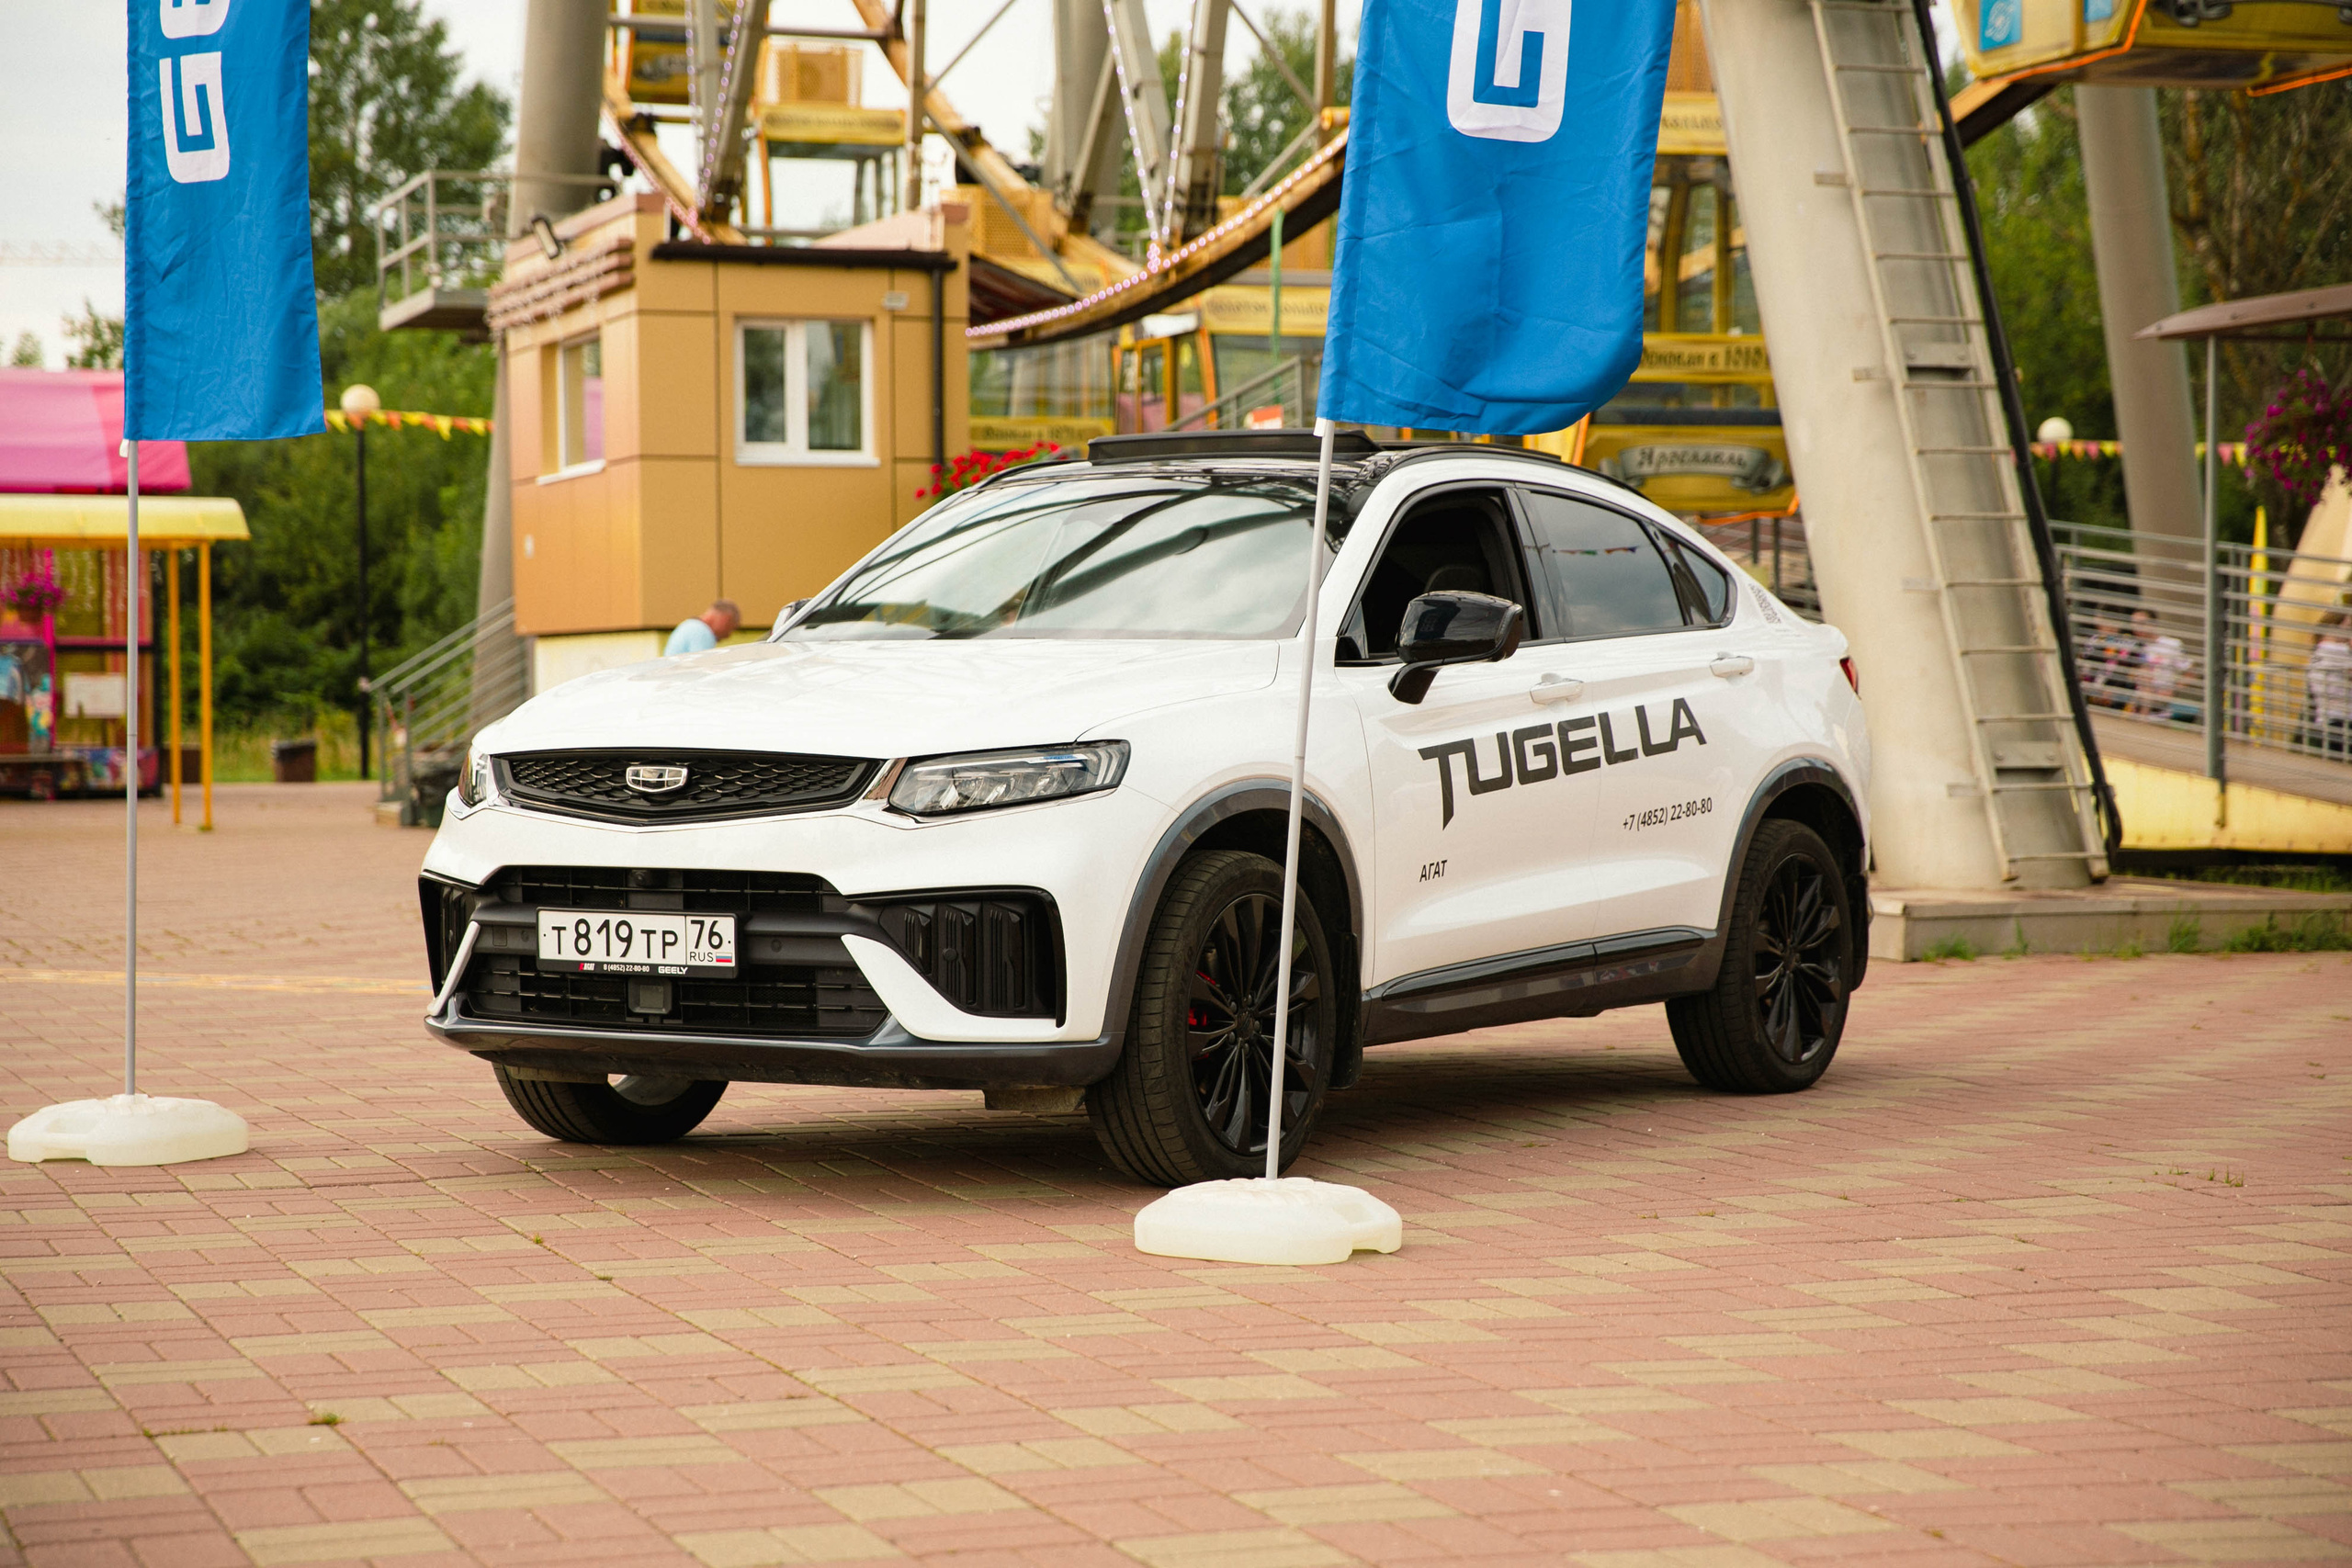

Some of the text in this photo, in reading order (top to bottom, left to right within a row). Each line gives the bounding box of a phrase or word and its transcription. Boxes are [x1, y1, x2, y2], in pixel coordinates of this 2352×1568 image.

[1418, 697, 1707, 831] TUGELLA
[1623, 796, 1713, 831] +7 (4852) 22-80-80
[1419, 859, 1448, 883] АГАТ
[551, 918, 724, 959] Т819ТР 76
[658, 965, 688, 975] GEELY
[689, 951, 714, 963] RUS
